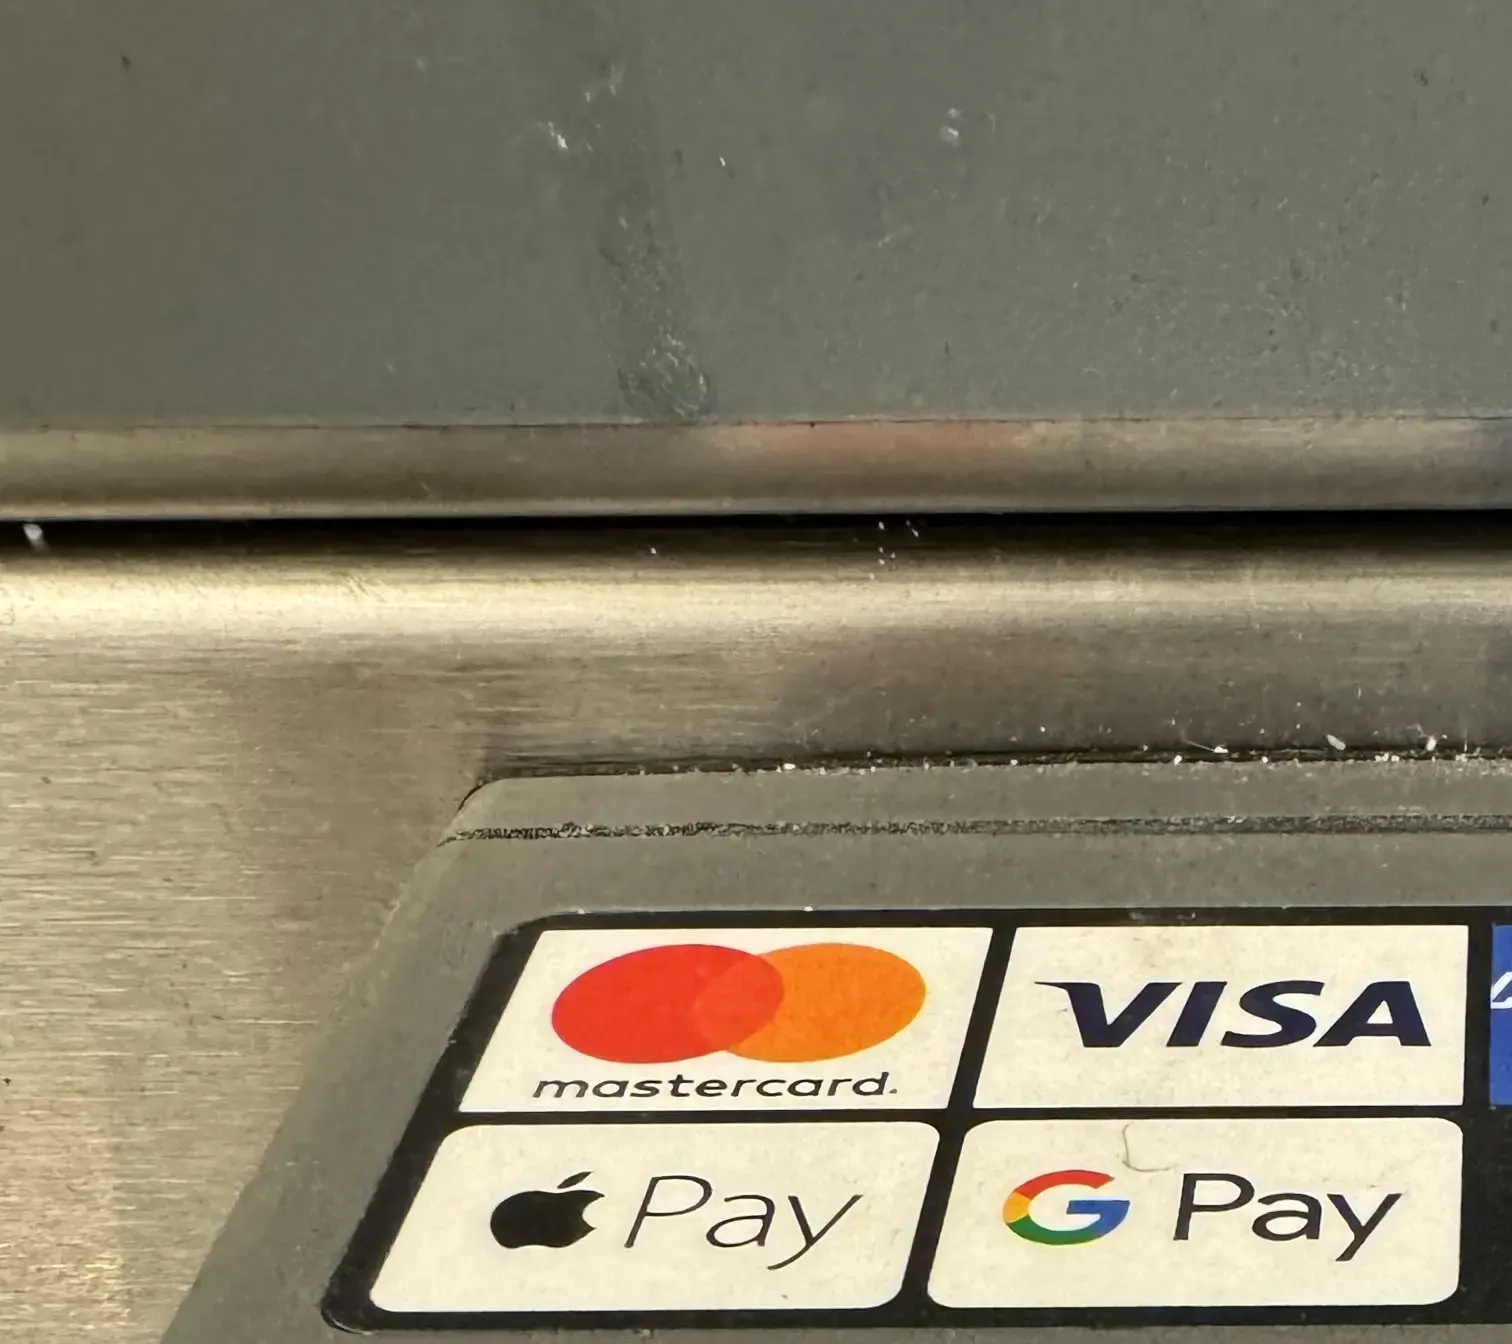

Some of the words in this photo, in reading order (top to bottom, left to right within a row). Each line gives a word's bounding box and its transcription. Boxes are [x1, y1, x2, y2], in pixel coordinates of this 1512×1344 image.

[1034, 979, 1433, 1048] VISA
[624, 1175, 864, 1270] Pay
[1173, 1173, 1402, 1262] Pay
